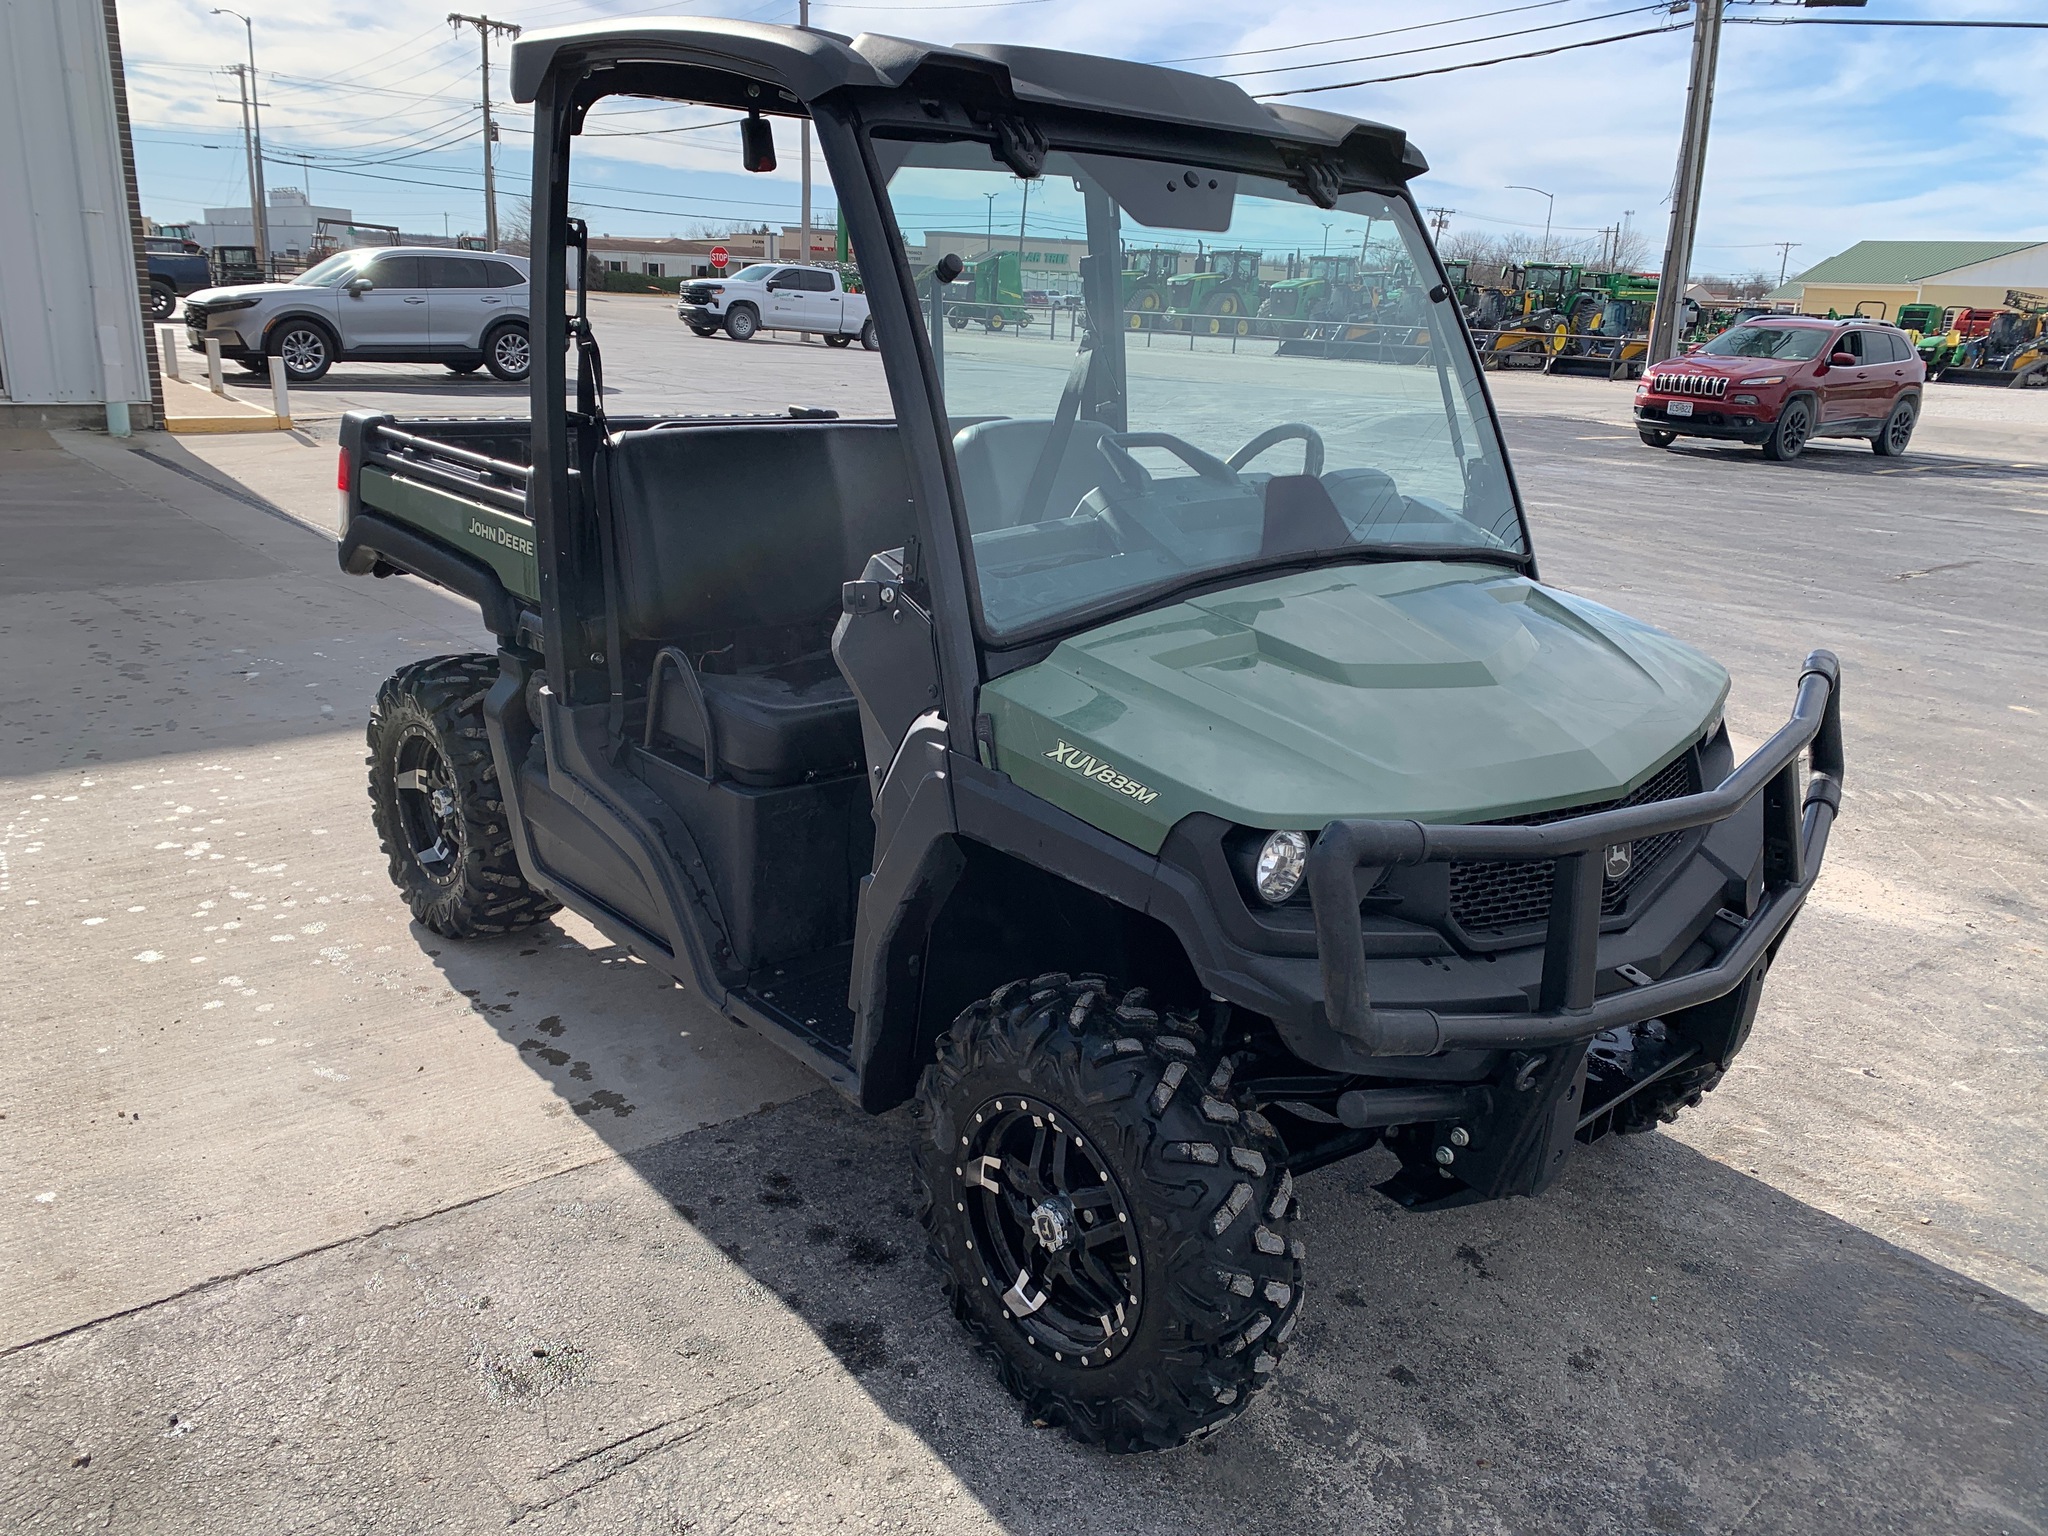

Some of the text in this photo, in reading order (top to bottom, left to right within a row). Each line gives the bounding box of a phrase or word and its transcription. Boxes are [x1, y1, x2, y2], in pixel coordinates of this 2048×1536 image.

[711, 252, 728, 262] STOP
[1044, 252, 1069, 264] TREE
[468, 517, 534, 557] JOHN DEERE
[1045, 741, 1160, 804] XUV835M
